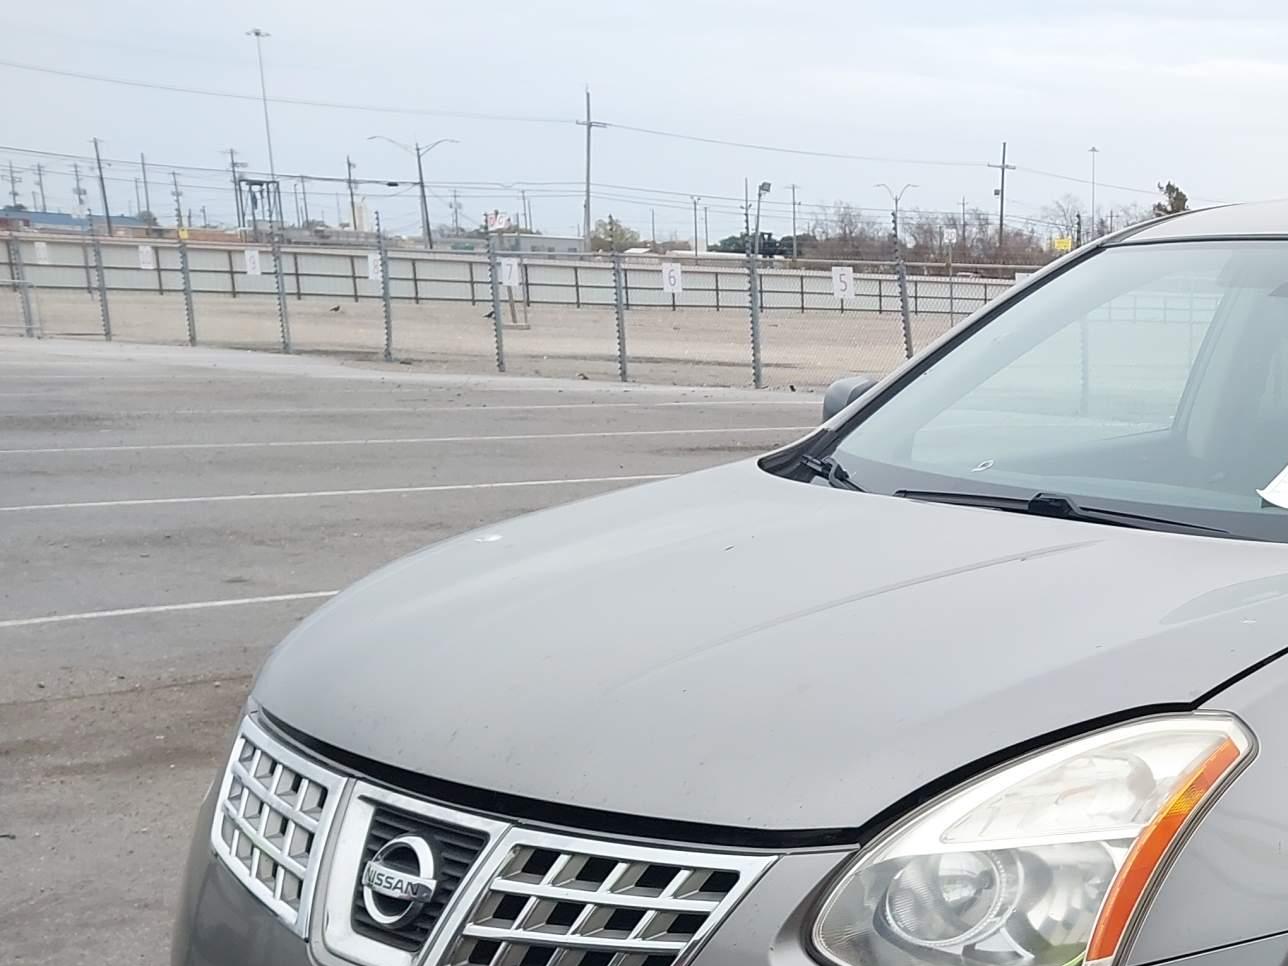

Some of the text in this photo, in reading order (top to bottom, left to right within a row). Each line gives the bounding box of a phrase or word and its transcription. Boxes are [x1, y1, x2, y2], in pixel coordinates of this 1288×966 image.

[505, 263, 513, 281] 7
[668, 269, 677, 287] 6
[839, 273, 848, 292] 5
[366, 865, 420, 897] NISSAN
